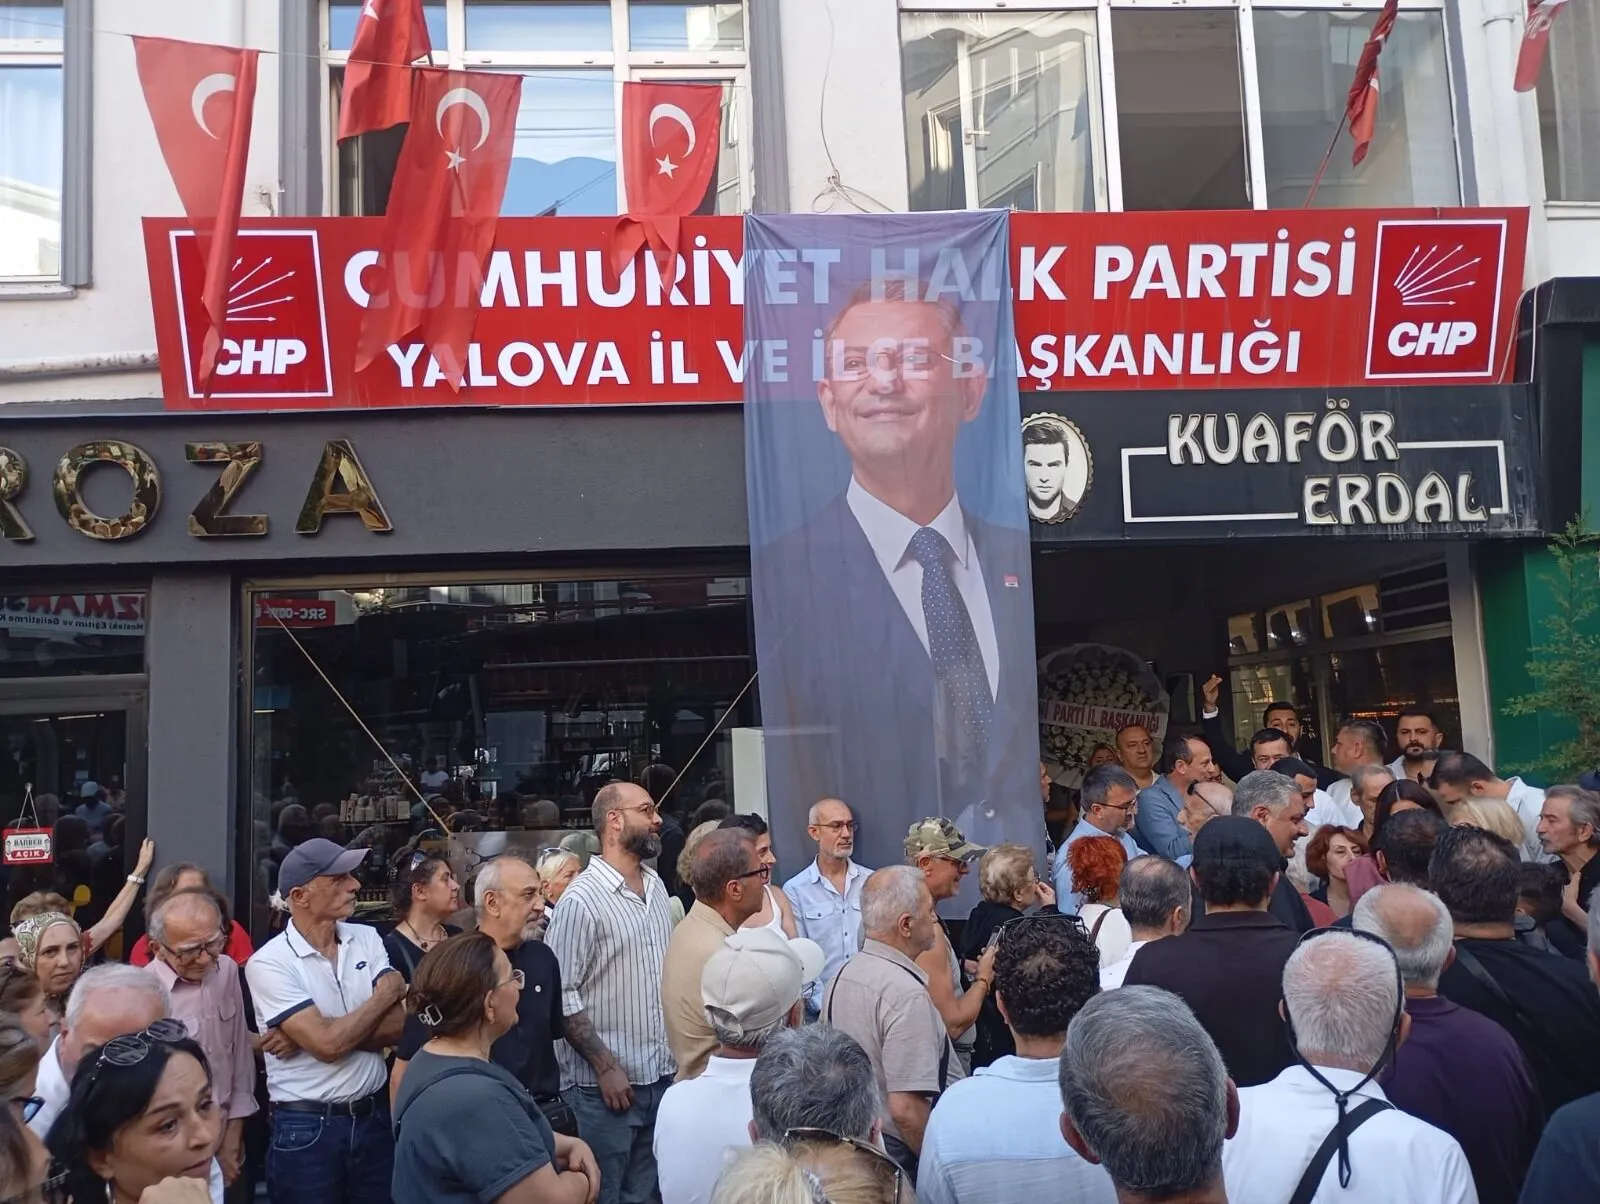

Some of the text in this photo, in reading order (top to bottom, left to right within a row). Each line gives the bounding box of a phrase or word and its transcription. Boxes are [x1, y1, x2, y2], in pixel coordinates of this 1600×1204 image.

[870, 246, 1067, 304] HALK
[1093, 227, 1356, 300] PARTİSİ
[216, 338, 307, 375] CHP
[386, 341, 631, 388] YALOVA
[650, 331, 699, 384] İL
[715, 338, 788, 384] VE
[951, 318, 1302, 392] BAŞKANLIĞI
[1387, 320, 1478, 357] CHP
[1167, 397, 1401, 466] KUAFÖR
[1303, 471, 1489, 526] ERDAL
[1053, 702, 1085, 725] PARTİ
